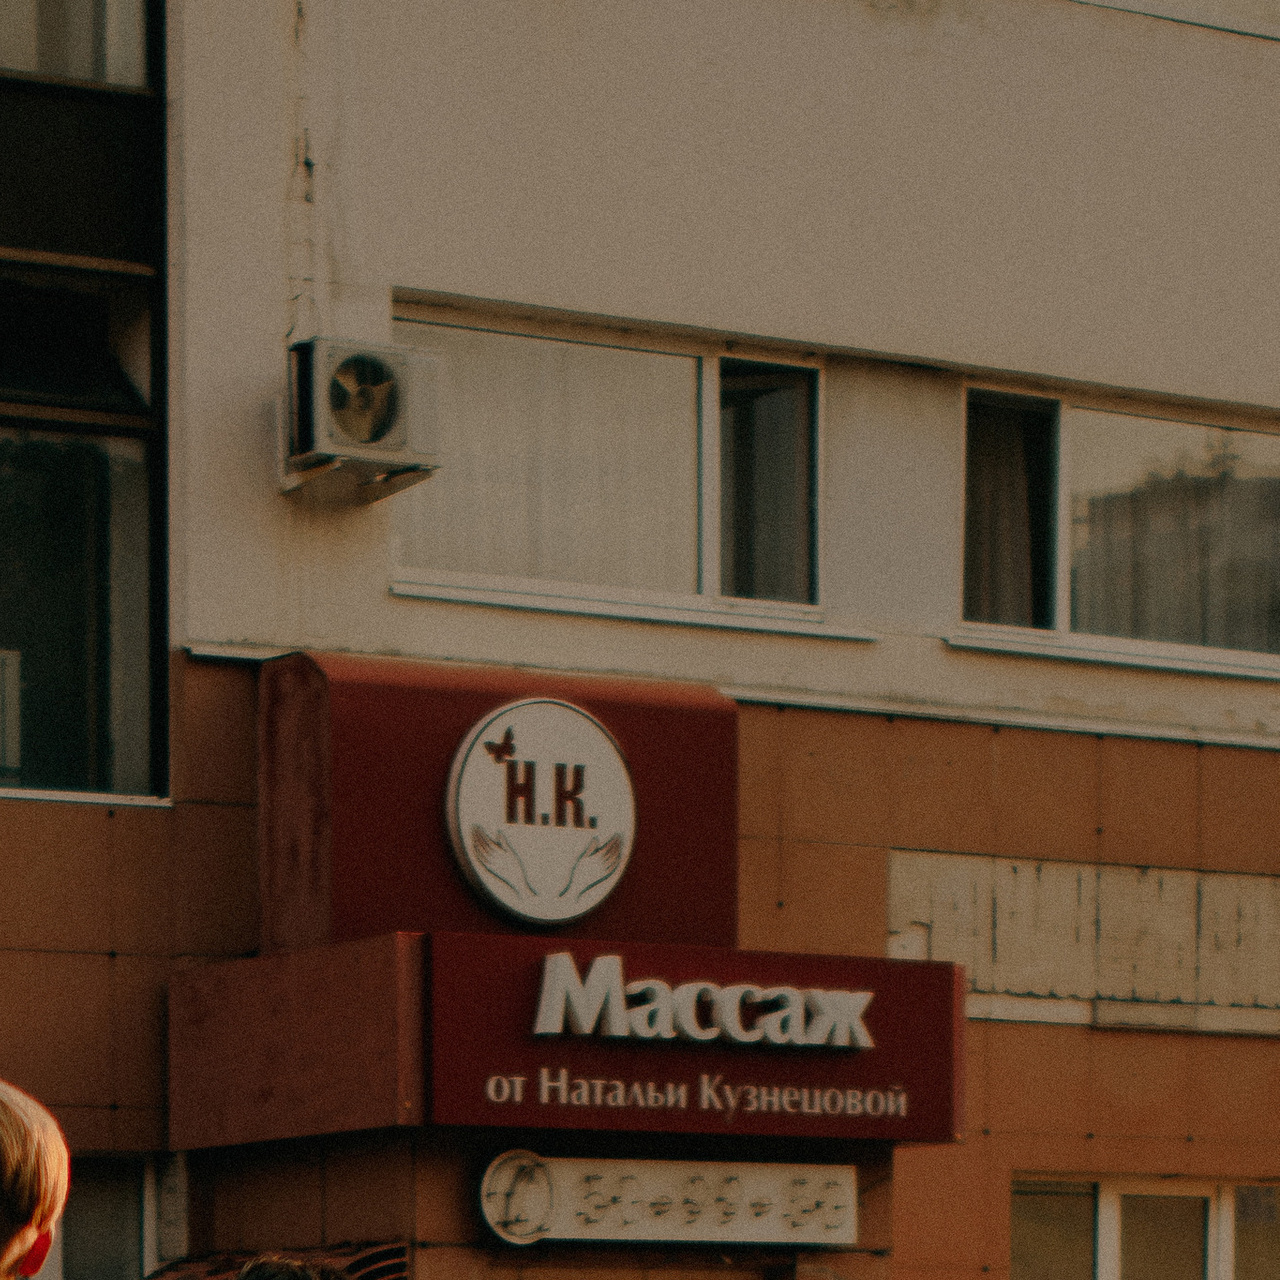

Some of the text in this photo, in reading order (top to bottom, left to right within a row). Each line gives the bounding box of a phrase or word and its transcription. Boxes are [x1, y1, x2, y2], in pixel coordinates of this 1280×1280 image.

[533, 952, 876, 1050] Массаж
[486, 1067, 908, 1122] от Натальи Кузнецовой
